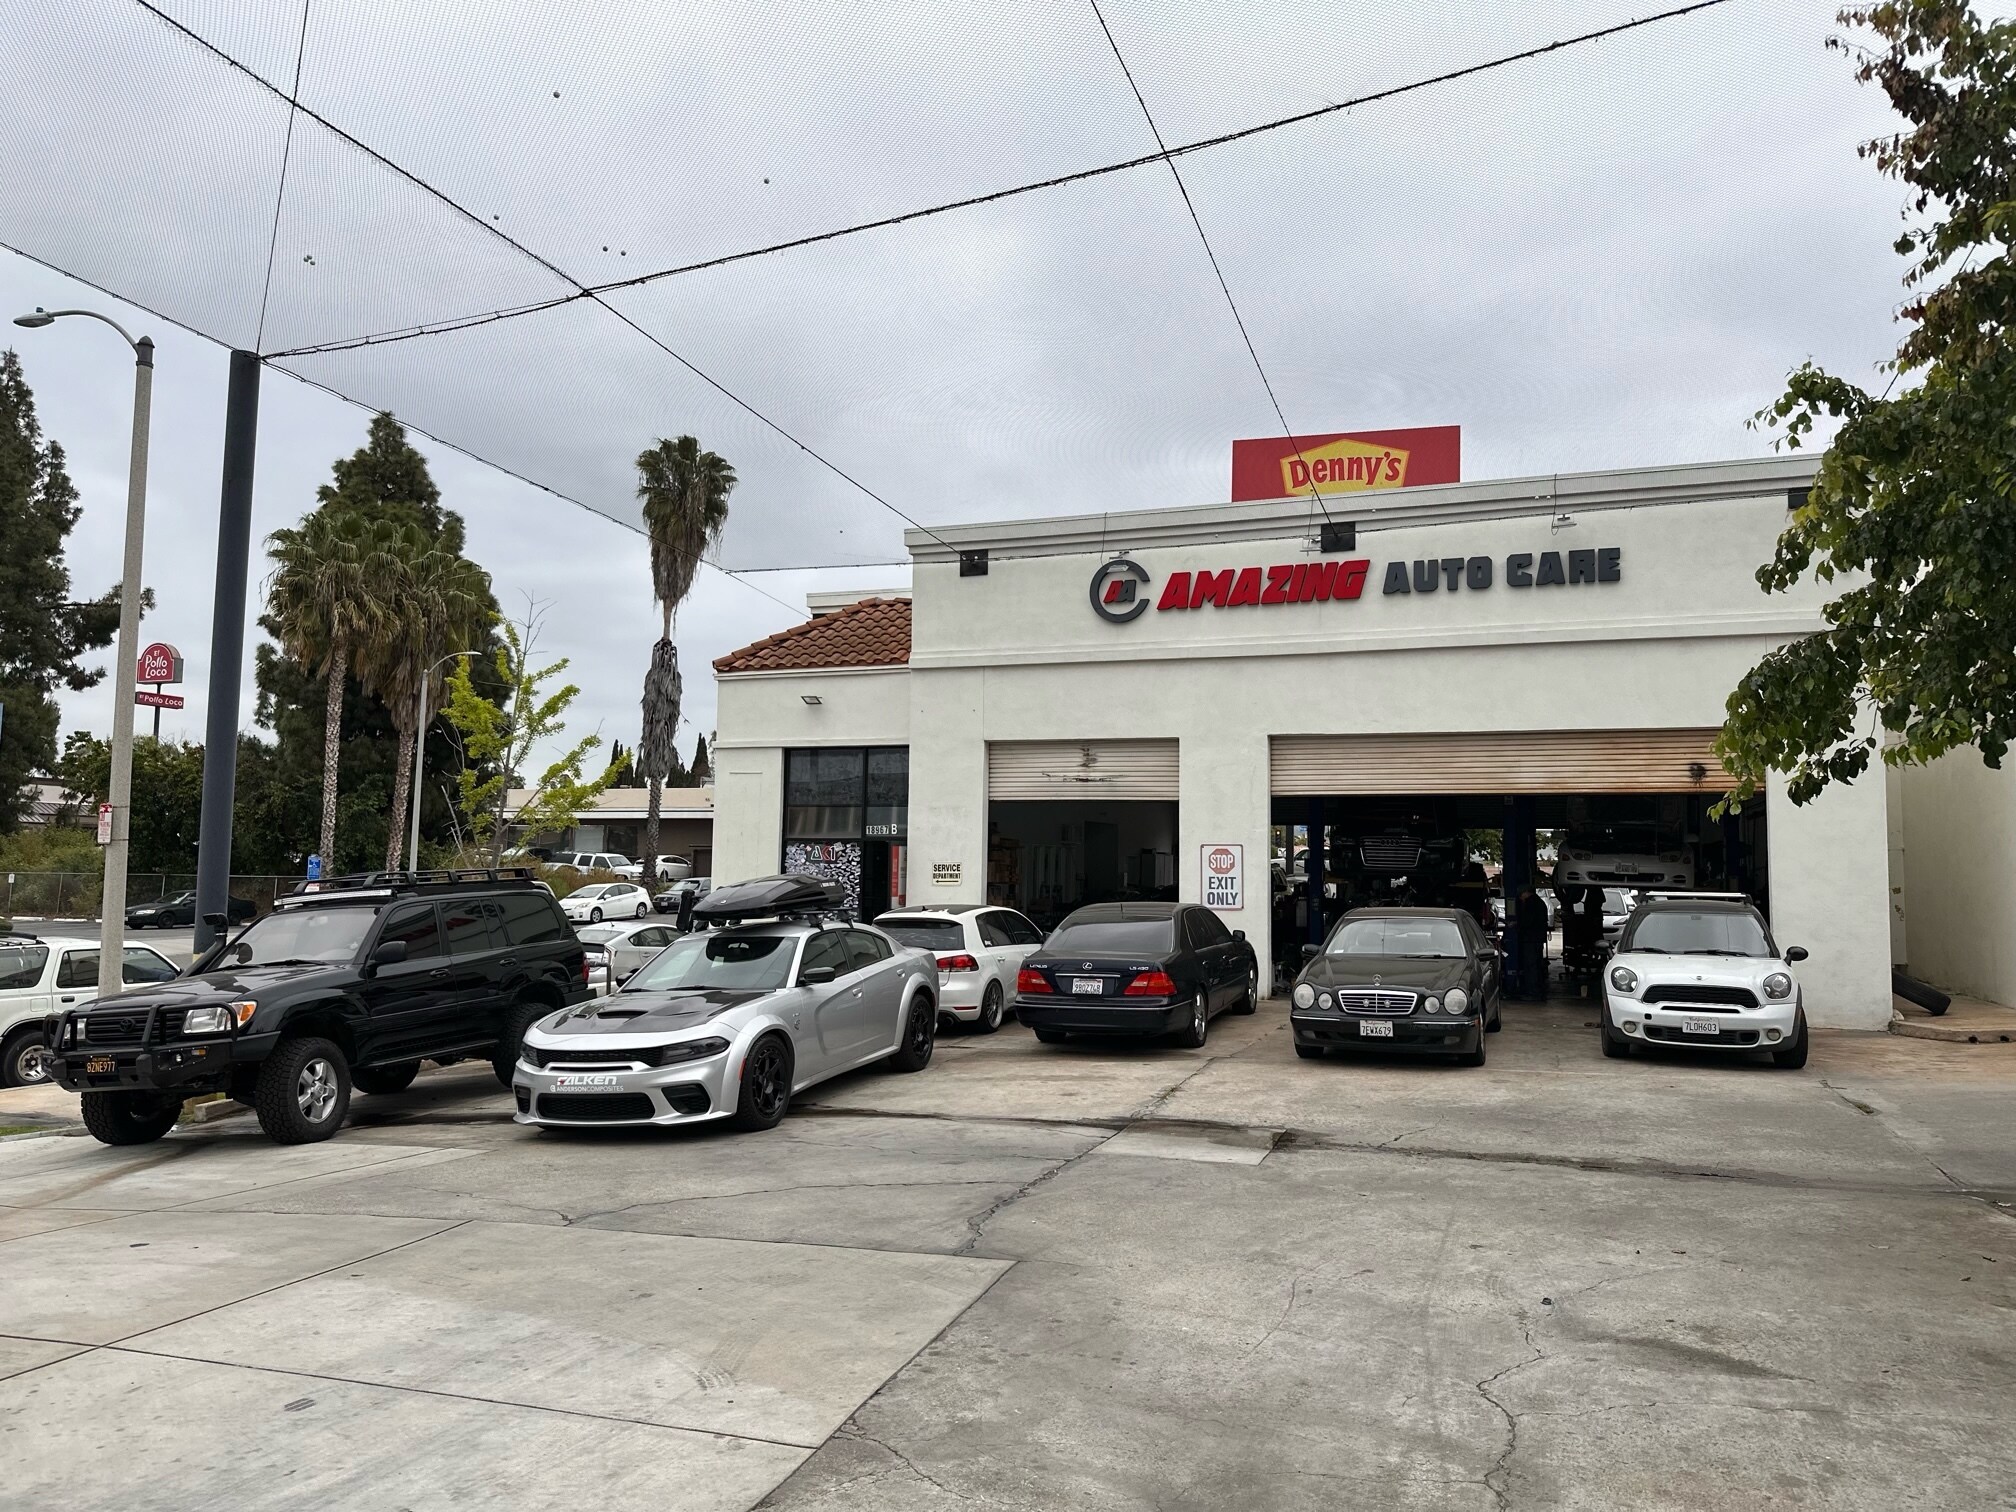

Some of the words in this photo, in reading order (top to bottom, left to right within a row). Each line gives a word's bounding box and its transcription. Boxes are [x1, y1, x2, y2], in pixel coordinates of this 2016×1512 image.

[1288, 451, 1401, 488] Denny's
[1157, 559, 1371, 612] AMAZING
[1382, 556, 1493, 595] AUTO
[1506, 547, 1621, 587] CARE
[145, 655, 168, 668] Pollo
[145, 667, 167, 679] Loco
[144, 694, 163, 704] Pollo
[165, 697, 183, 706] Loco
[891, 824, 898, 835] B
[933, 864, 961, 872] SERVICE
[1210, 854, 1234, 869] STOP
[1208, 876, 1237, 890] EXIT
[1207, 892, 1239, 906] ONLY
[557, 1076, 617, 1086] FALKEN
